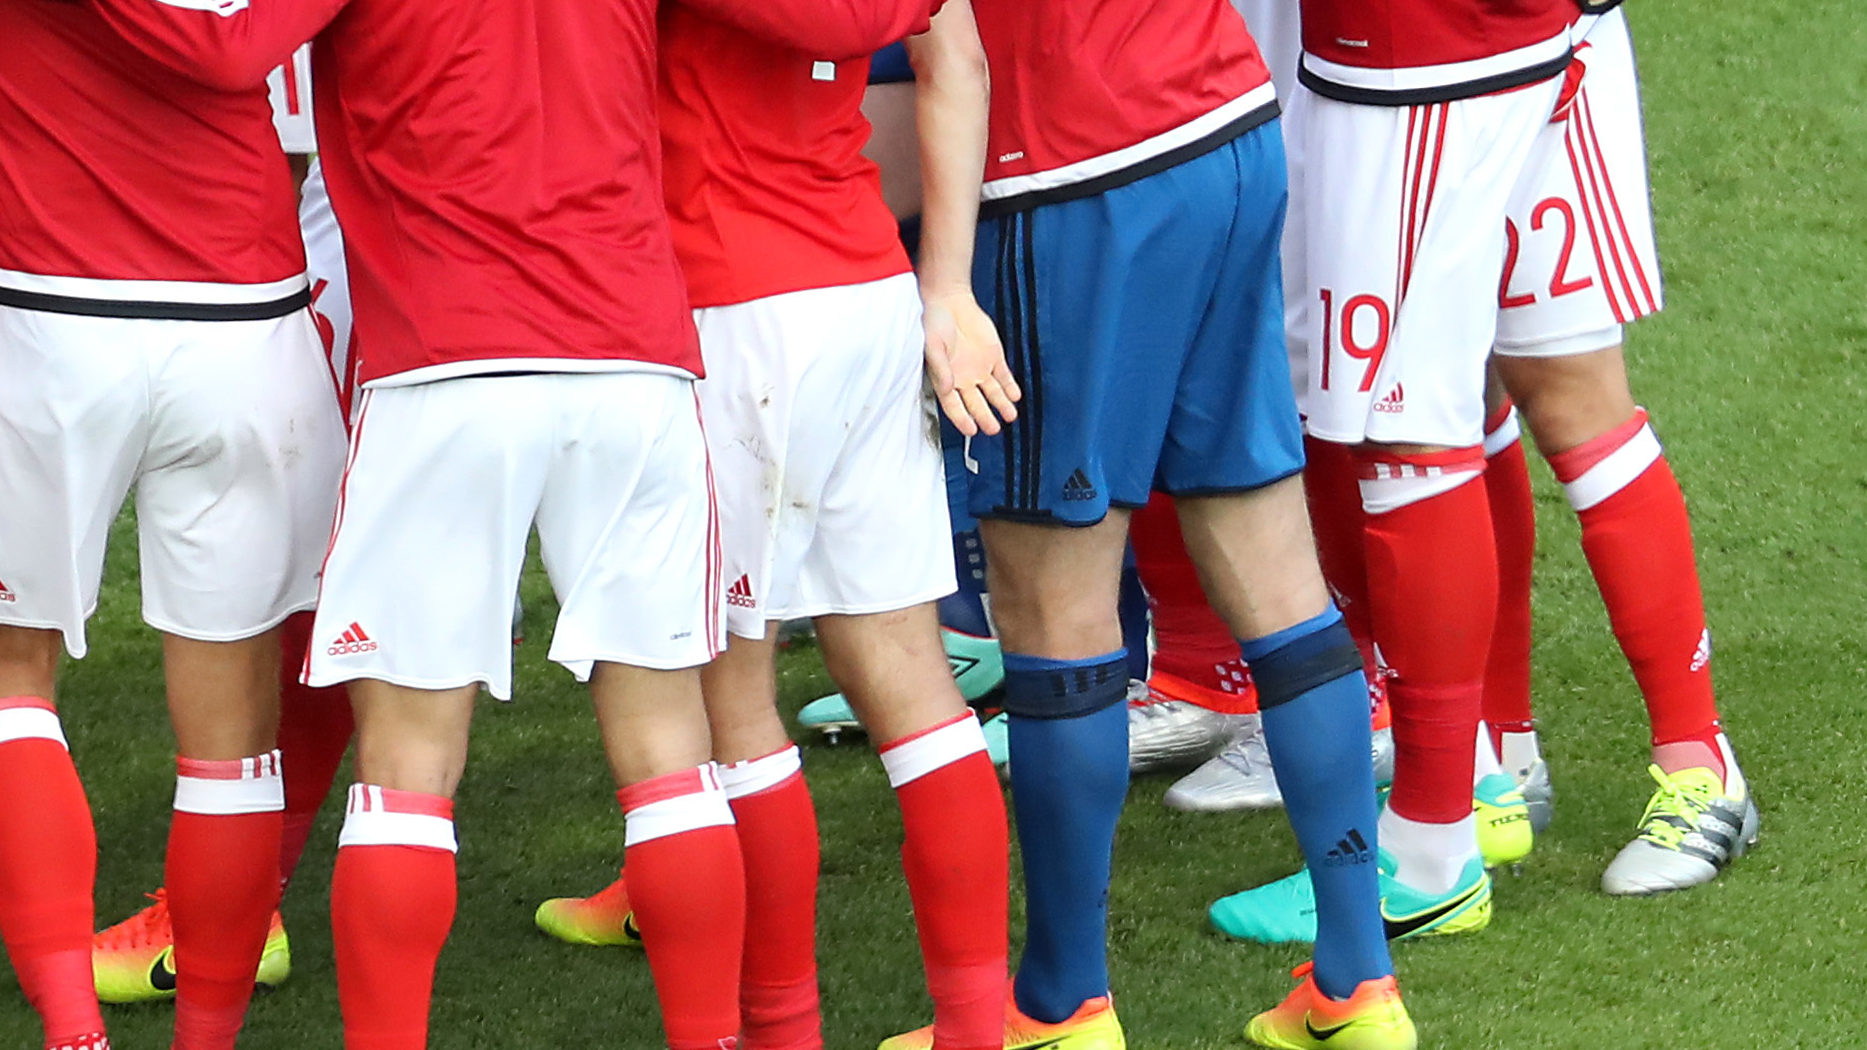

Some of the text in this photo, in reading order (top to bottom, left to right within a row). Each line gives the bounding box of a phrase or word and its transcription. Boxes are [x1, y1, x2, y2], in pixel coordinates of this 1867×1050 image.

[1499, 196, 1594, 311] 22
[1319, 288, 1391, 393] 19
[327, 640, 379, 657] adidas
